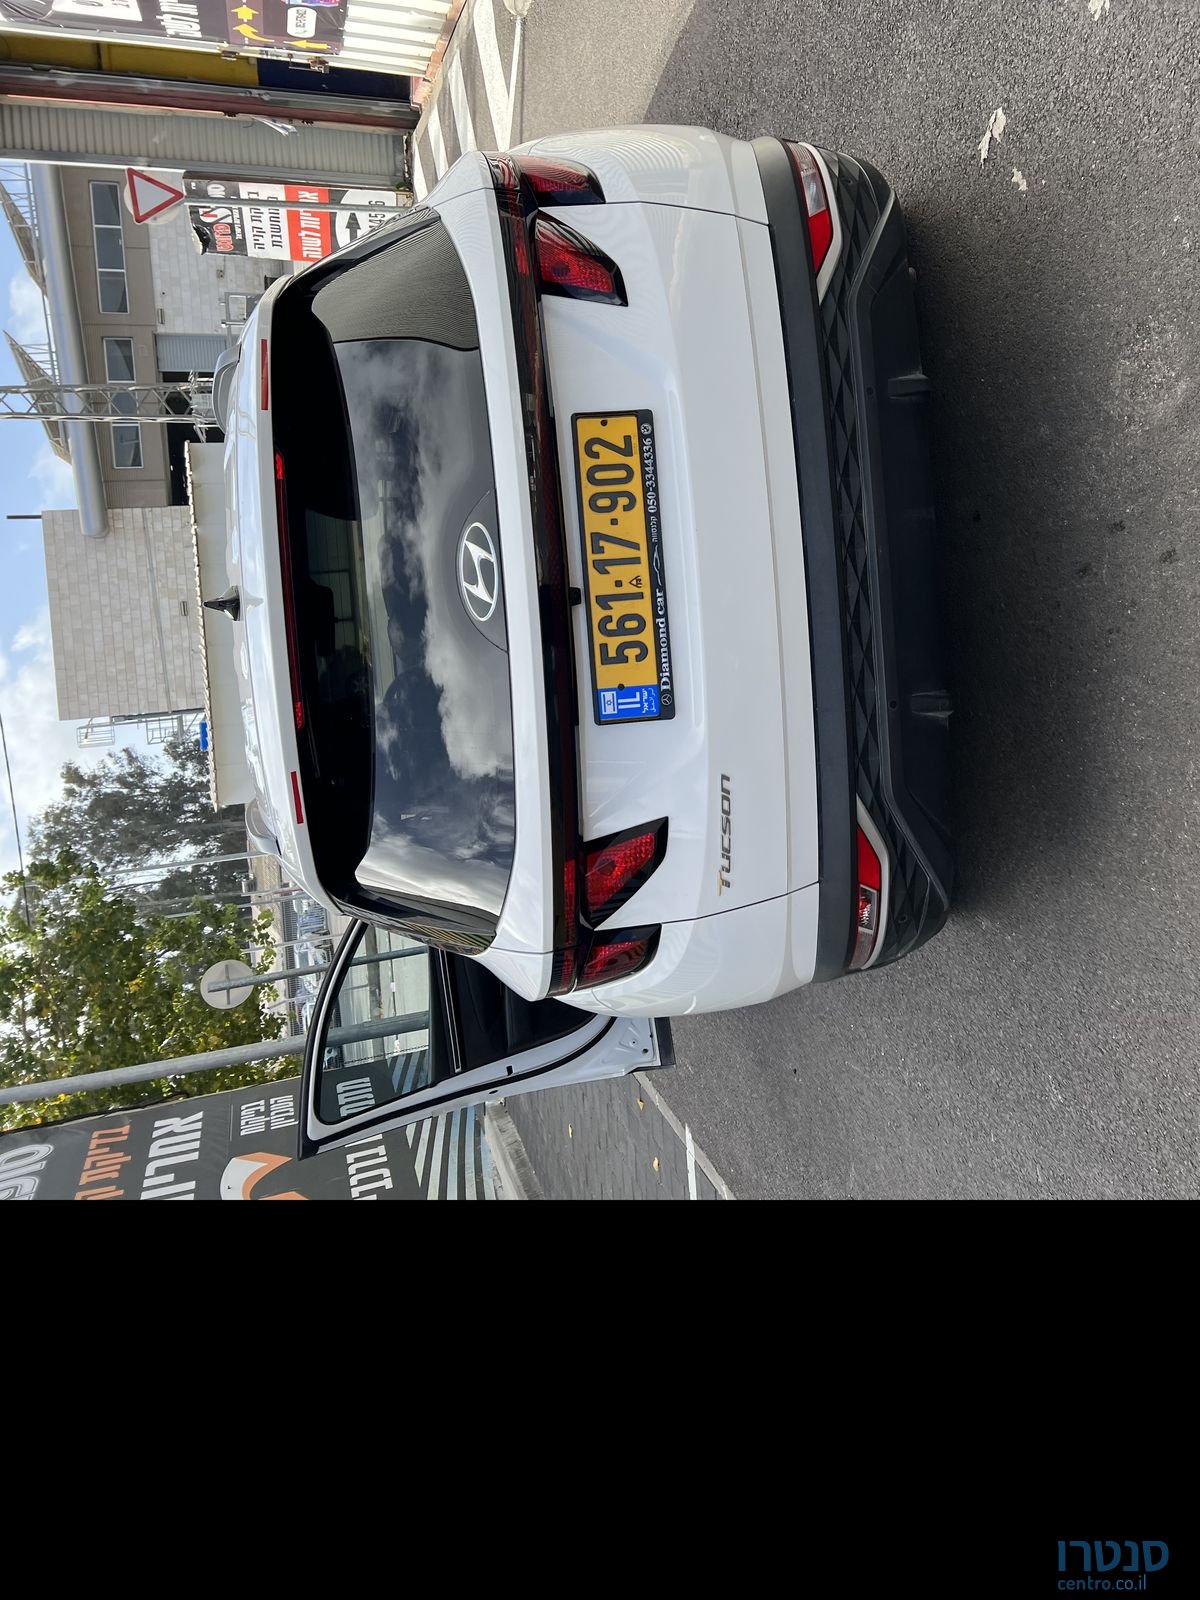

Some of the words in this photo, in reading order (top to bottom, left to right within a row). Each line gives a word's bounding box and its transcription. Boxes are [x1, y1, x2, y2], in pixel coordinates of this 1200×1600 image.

[248, 192, 264, 223] בקת
[298, 190, 320, 230] איות
[252, 226, 266, 250] קניה
[298, 230, 322, 259] לשנה
[642, 438, 658, 513] 050-3344336
[655, 588, 665, 616] car
[656, 618, 672, 691] Diamond
[618, 692, 642, 710] IL
[240, 1100, 270, 1136] בפיקוח
[270, 1095, 299, 1130] הטכניון
[0, 1144, 54, 1200] סופ
[78, 1124, 132, 1186] בדיקת
[140, 1111, 204, 1200] אחריו
